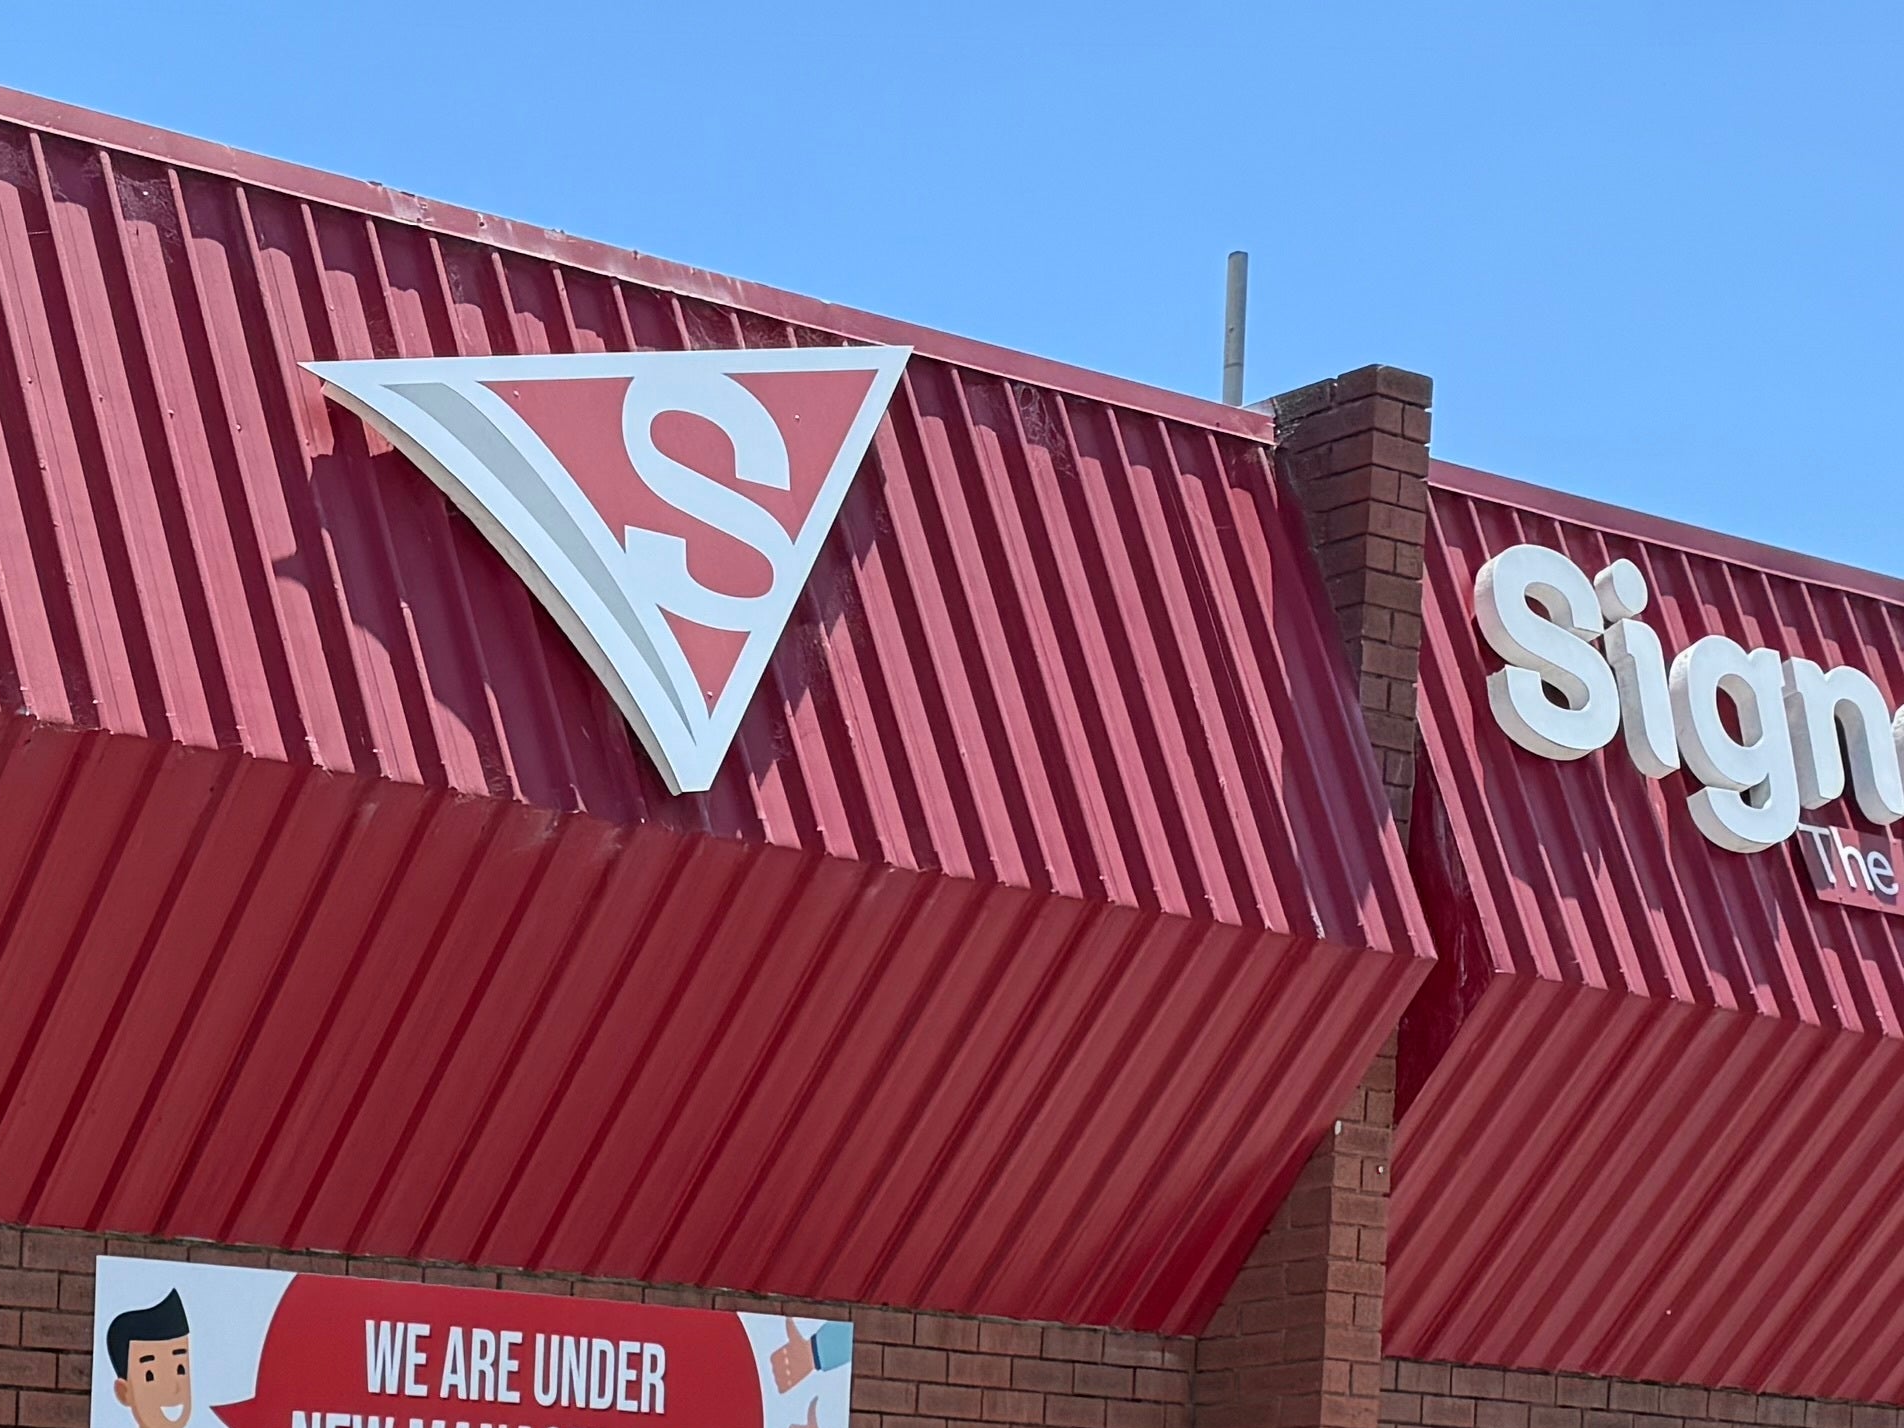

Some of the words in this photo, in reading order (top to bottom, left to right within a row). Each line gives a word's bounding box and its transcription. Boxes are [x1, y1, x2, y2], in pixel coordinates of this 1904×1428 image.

[1475, 544, 1904, 853] Sign
[1797, 823, 1899, 895] The
[365, 1320, 432, 1396] WE
[440, 1327, 521, 1405] ARE
[534, 1334, 666, 1415] UNDER
